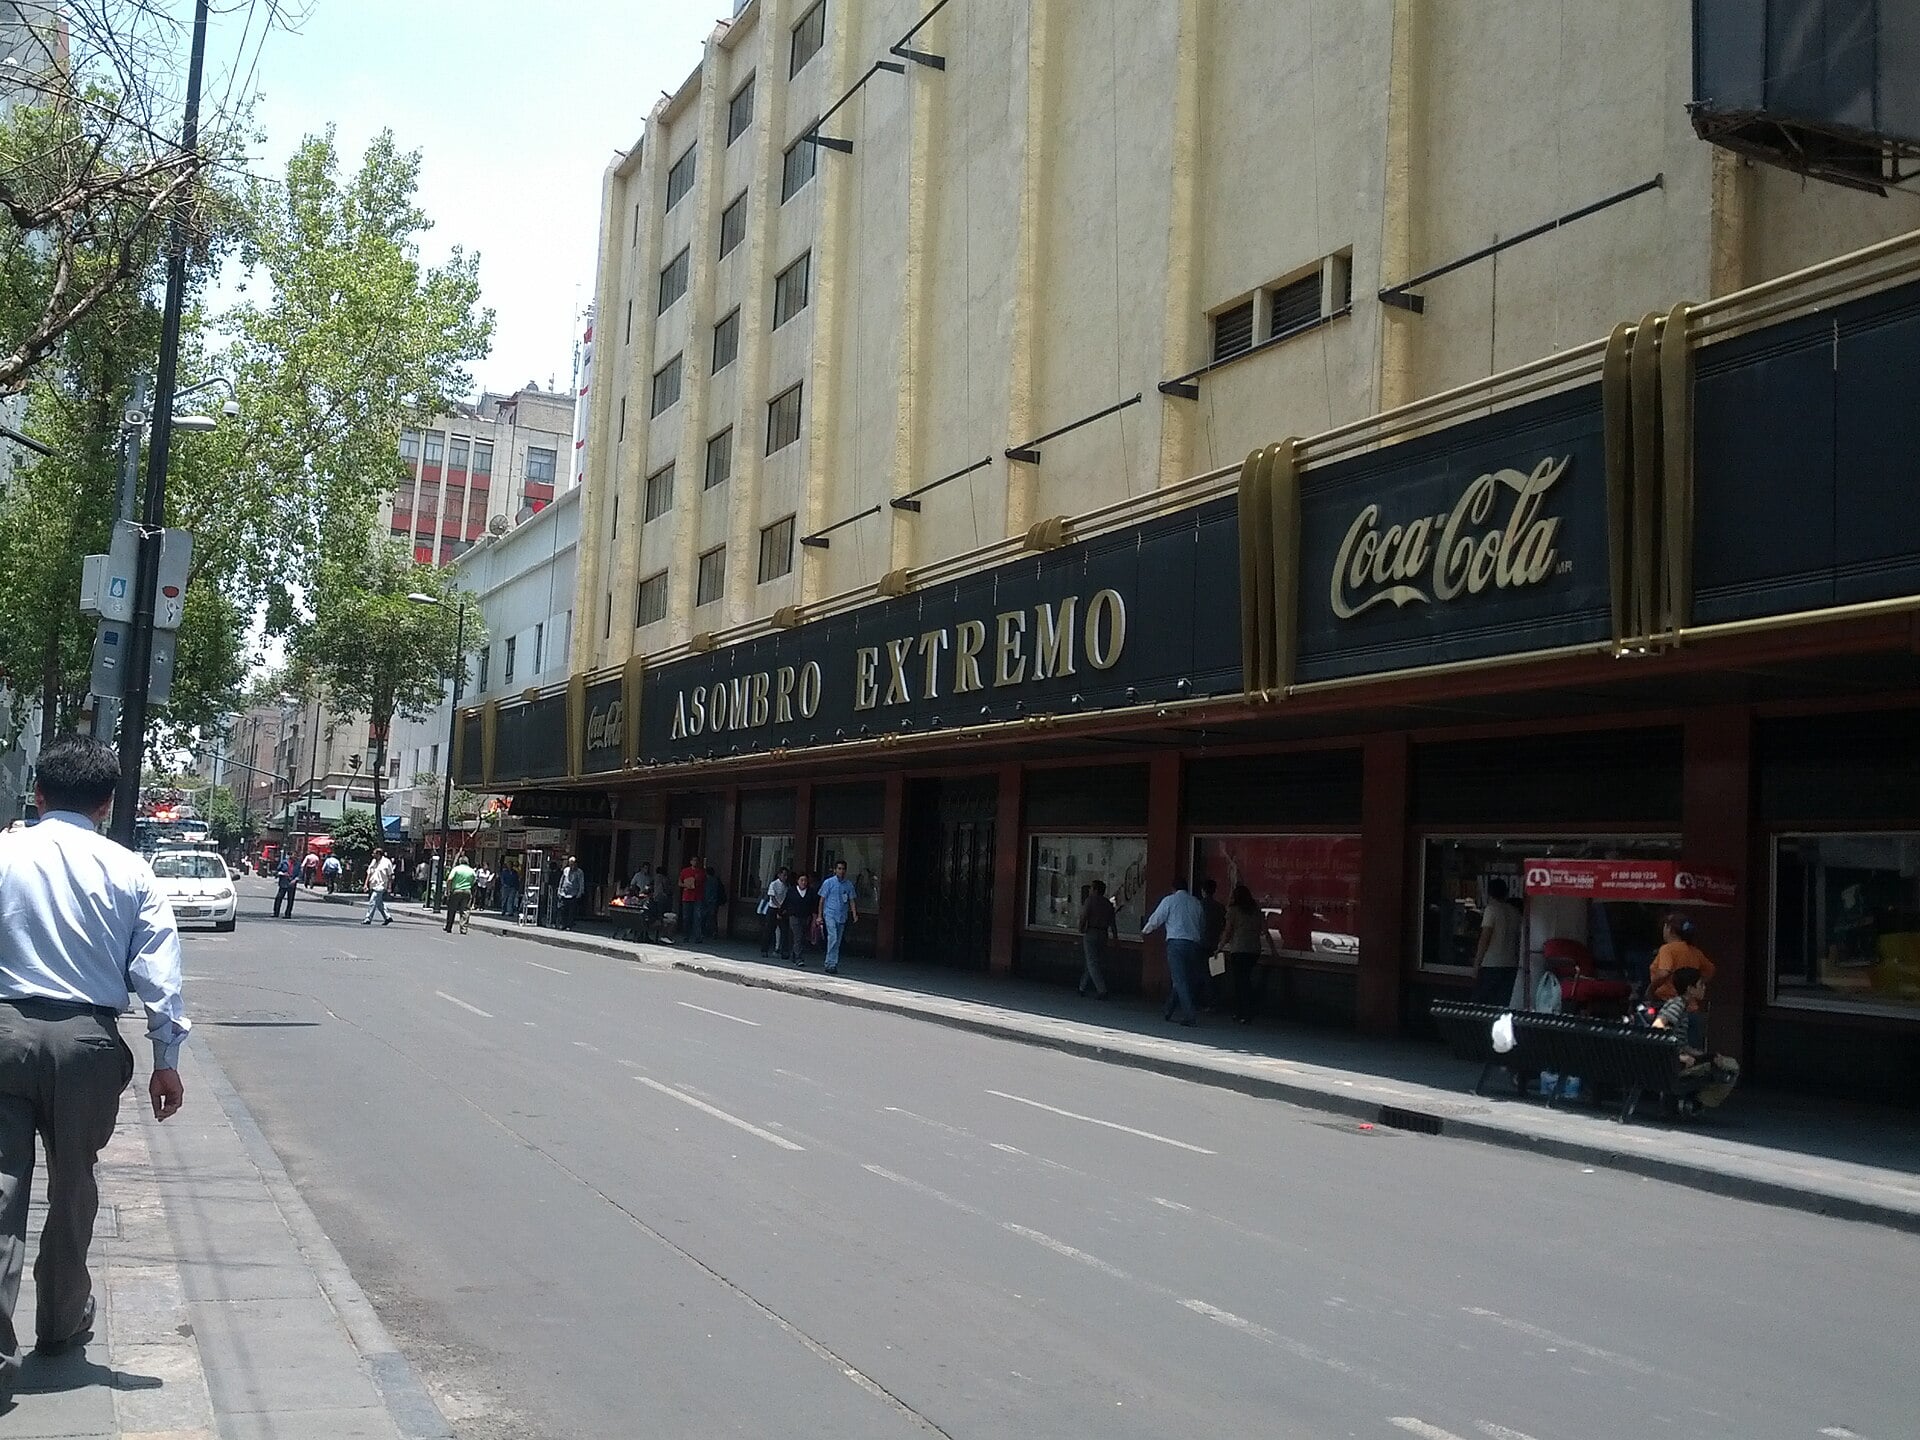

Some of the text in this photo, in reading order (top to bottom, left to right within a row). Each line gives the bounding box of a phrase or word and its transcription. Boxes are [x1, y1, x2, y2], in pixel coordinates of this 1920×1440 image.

[1331, 454, 1570, 618] Coca-Cola
[670, 588, 1126, 741] ASOMBRO EXTREMO
